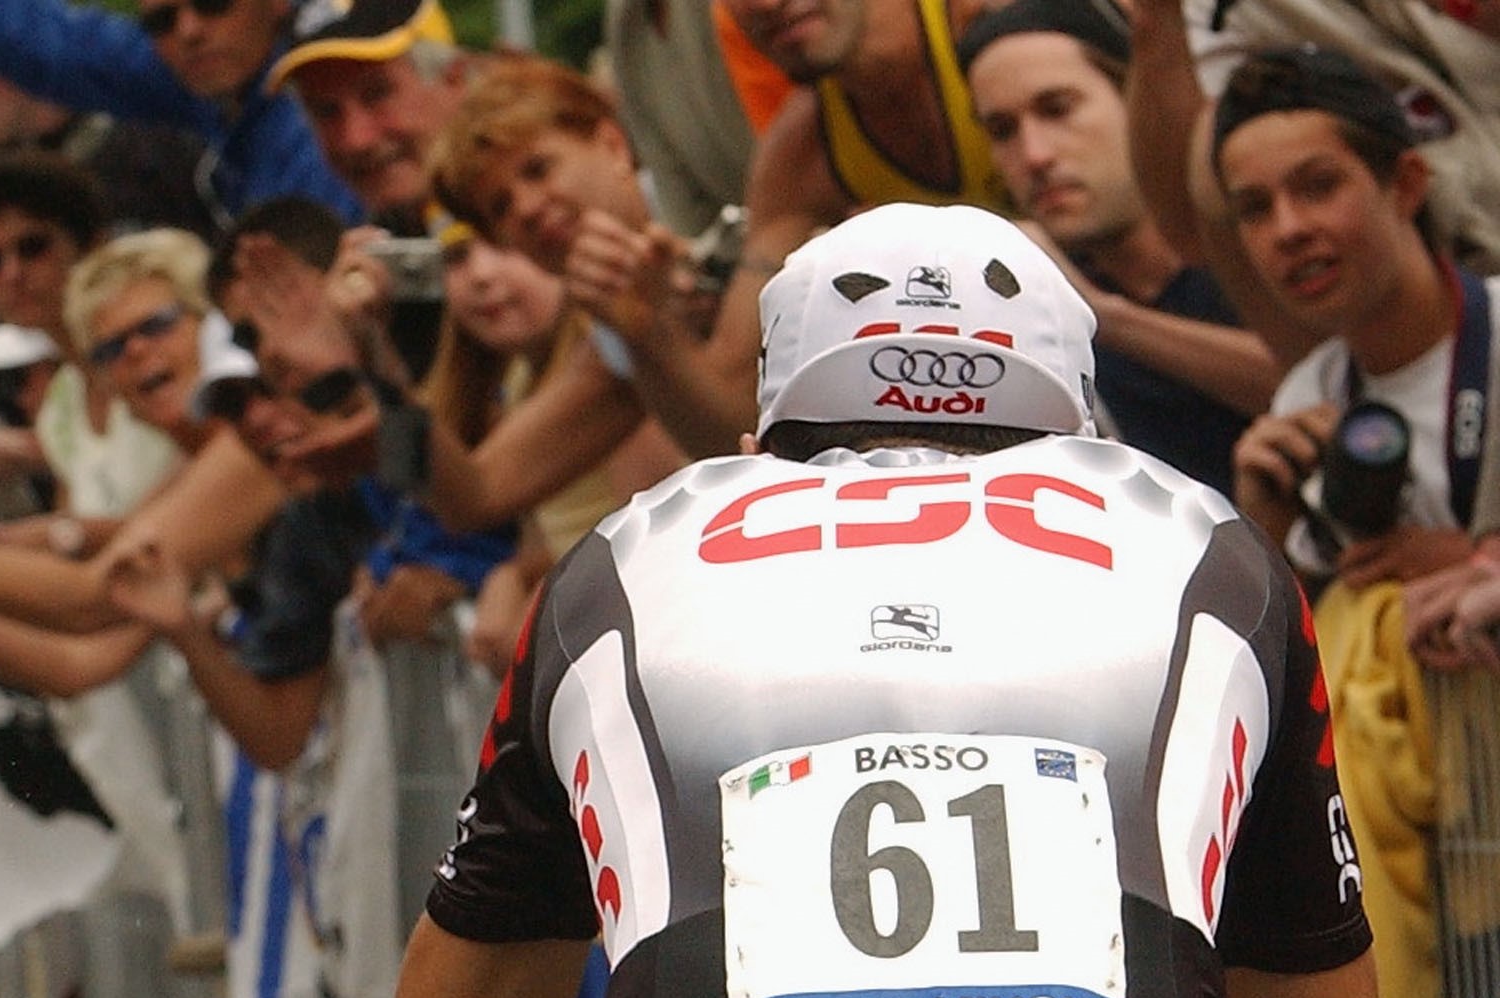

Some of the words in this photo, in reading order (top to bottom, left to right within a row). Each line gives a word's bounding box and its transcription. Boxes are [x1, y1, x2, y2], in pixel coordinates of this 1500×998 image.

[874, 385, 986, 414] Audi
[698, 473, 1113, 571] CSC
[855, 744, 989, 774] BASSO
[830, 779, 1040, 959] 61
